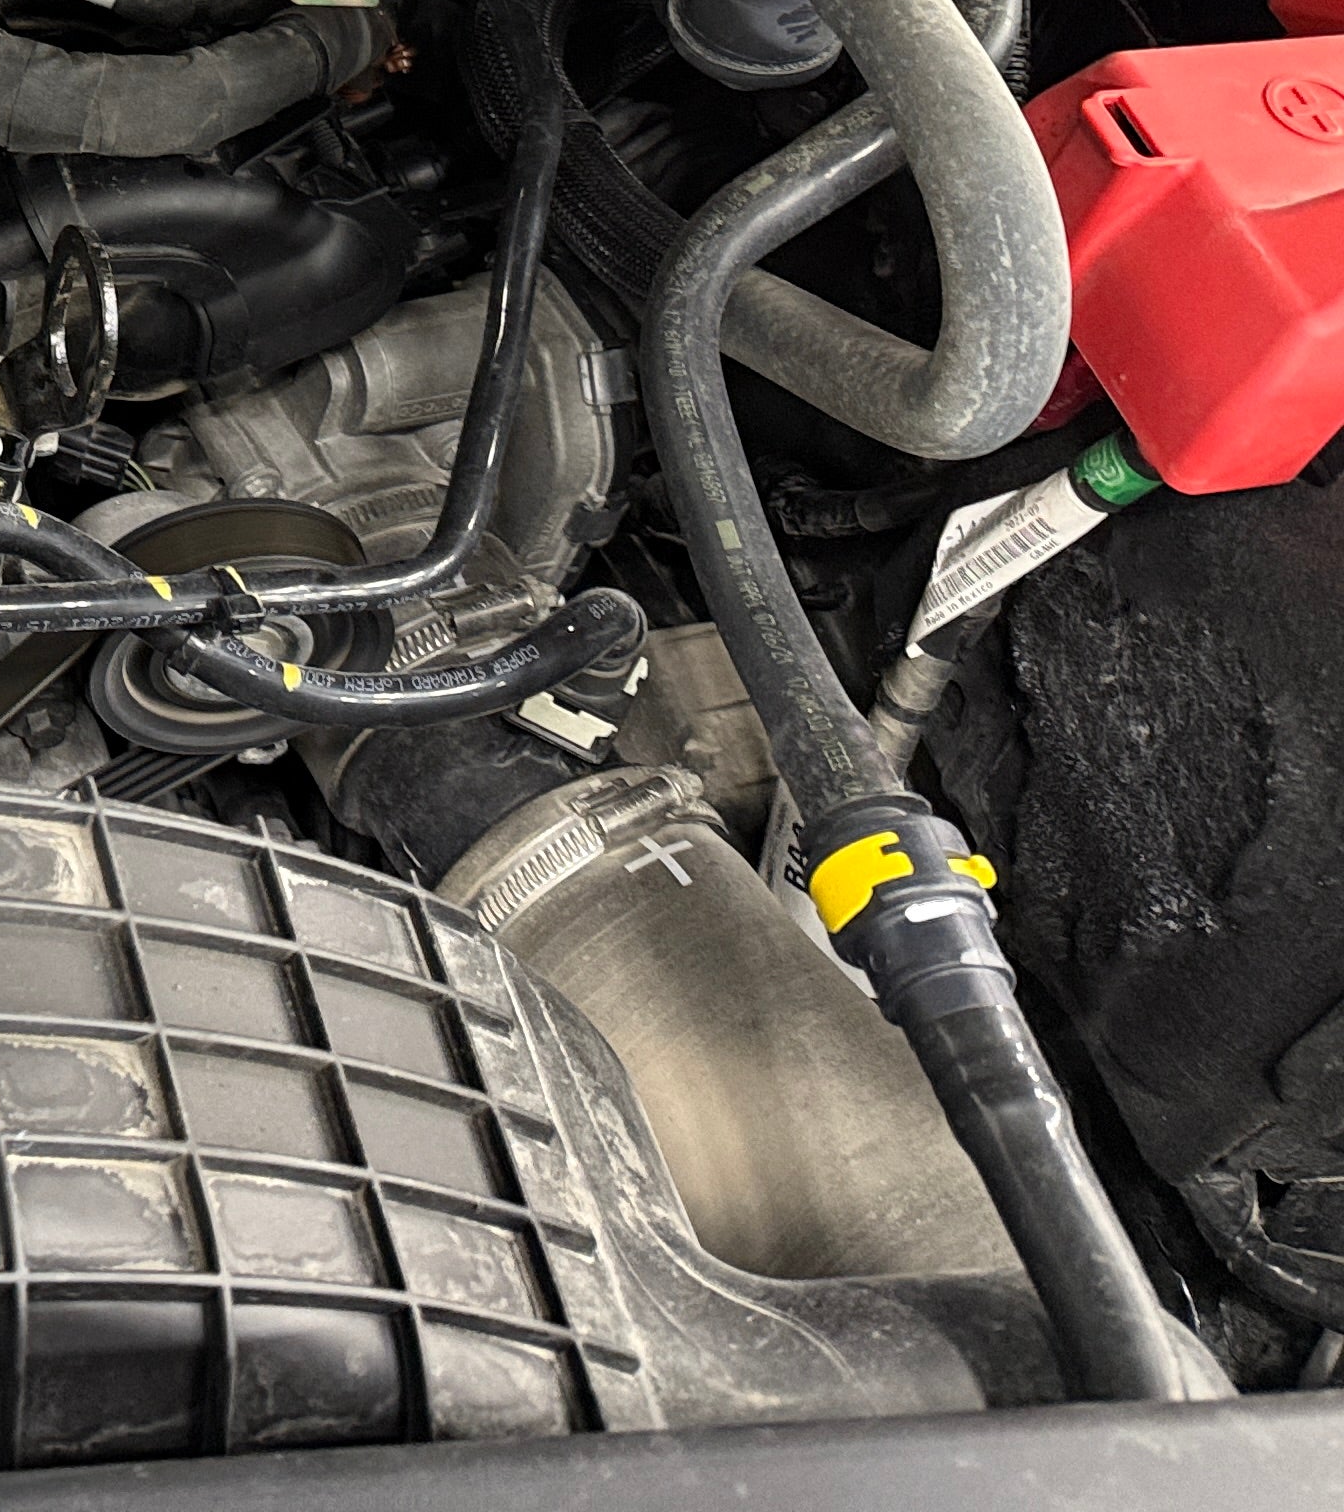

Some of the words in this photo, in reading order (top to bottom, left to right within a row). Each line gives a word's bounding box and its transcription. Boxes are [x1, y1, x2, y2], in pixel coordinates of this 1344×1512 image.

[924, 610, 946, 628] Made
[946, 602, 960, 614] in
[958, 581, 994, 606] Mexico
[493, 643, 541, 675] COOPER
[344, 674, 403, 692] LoPERM
[412, 667, 487, 690] STANDARD
